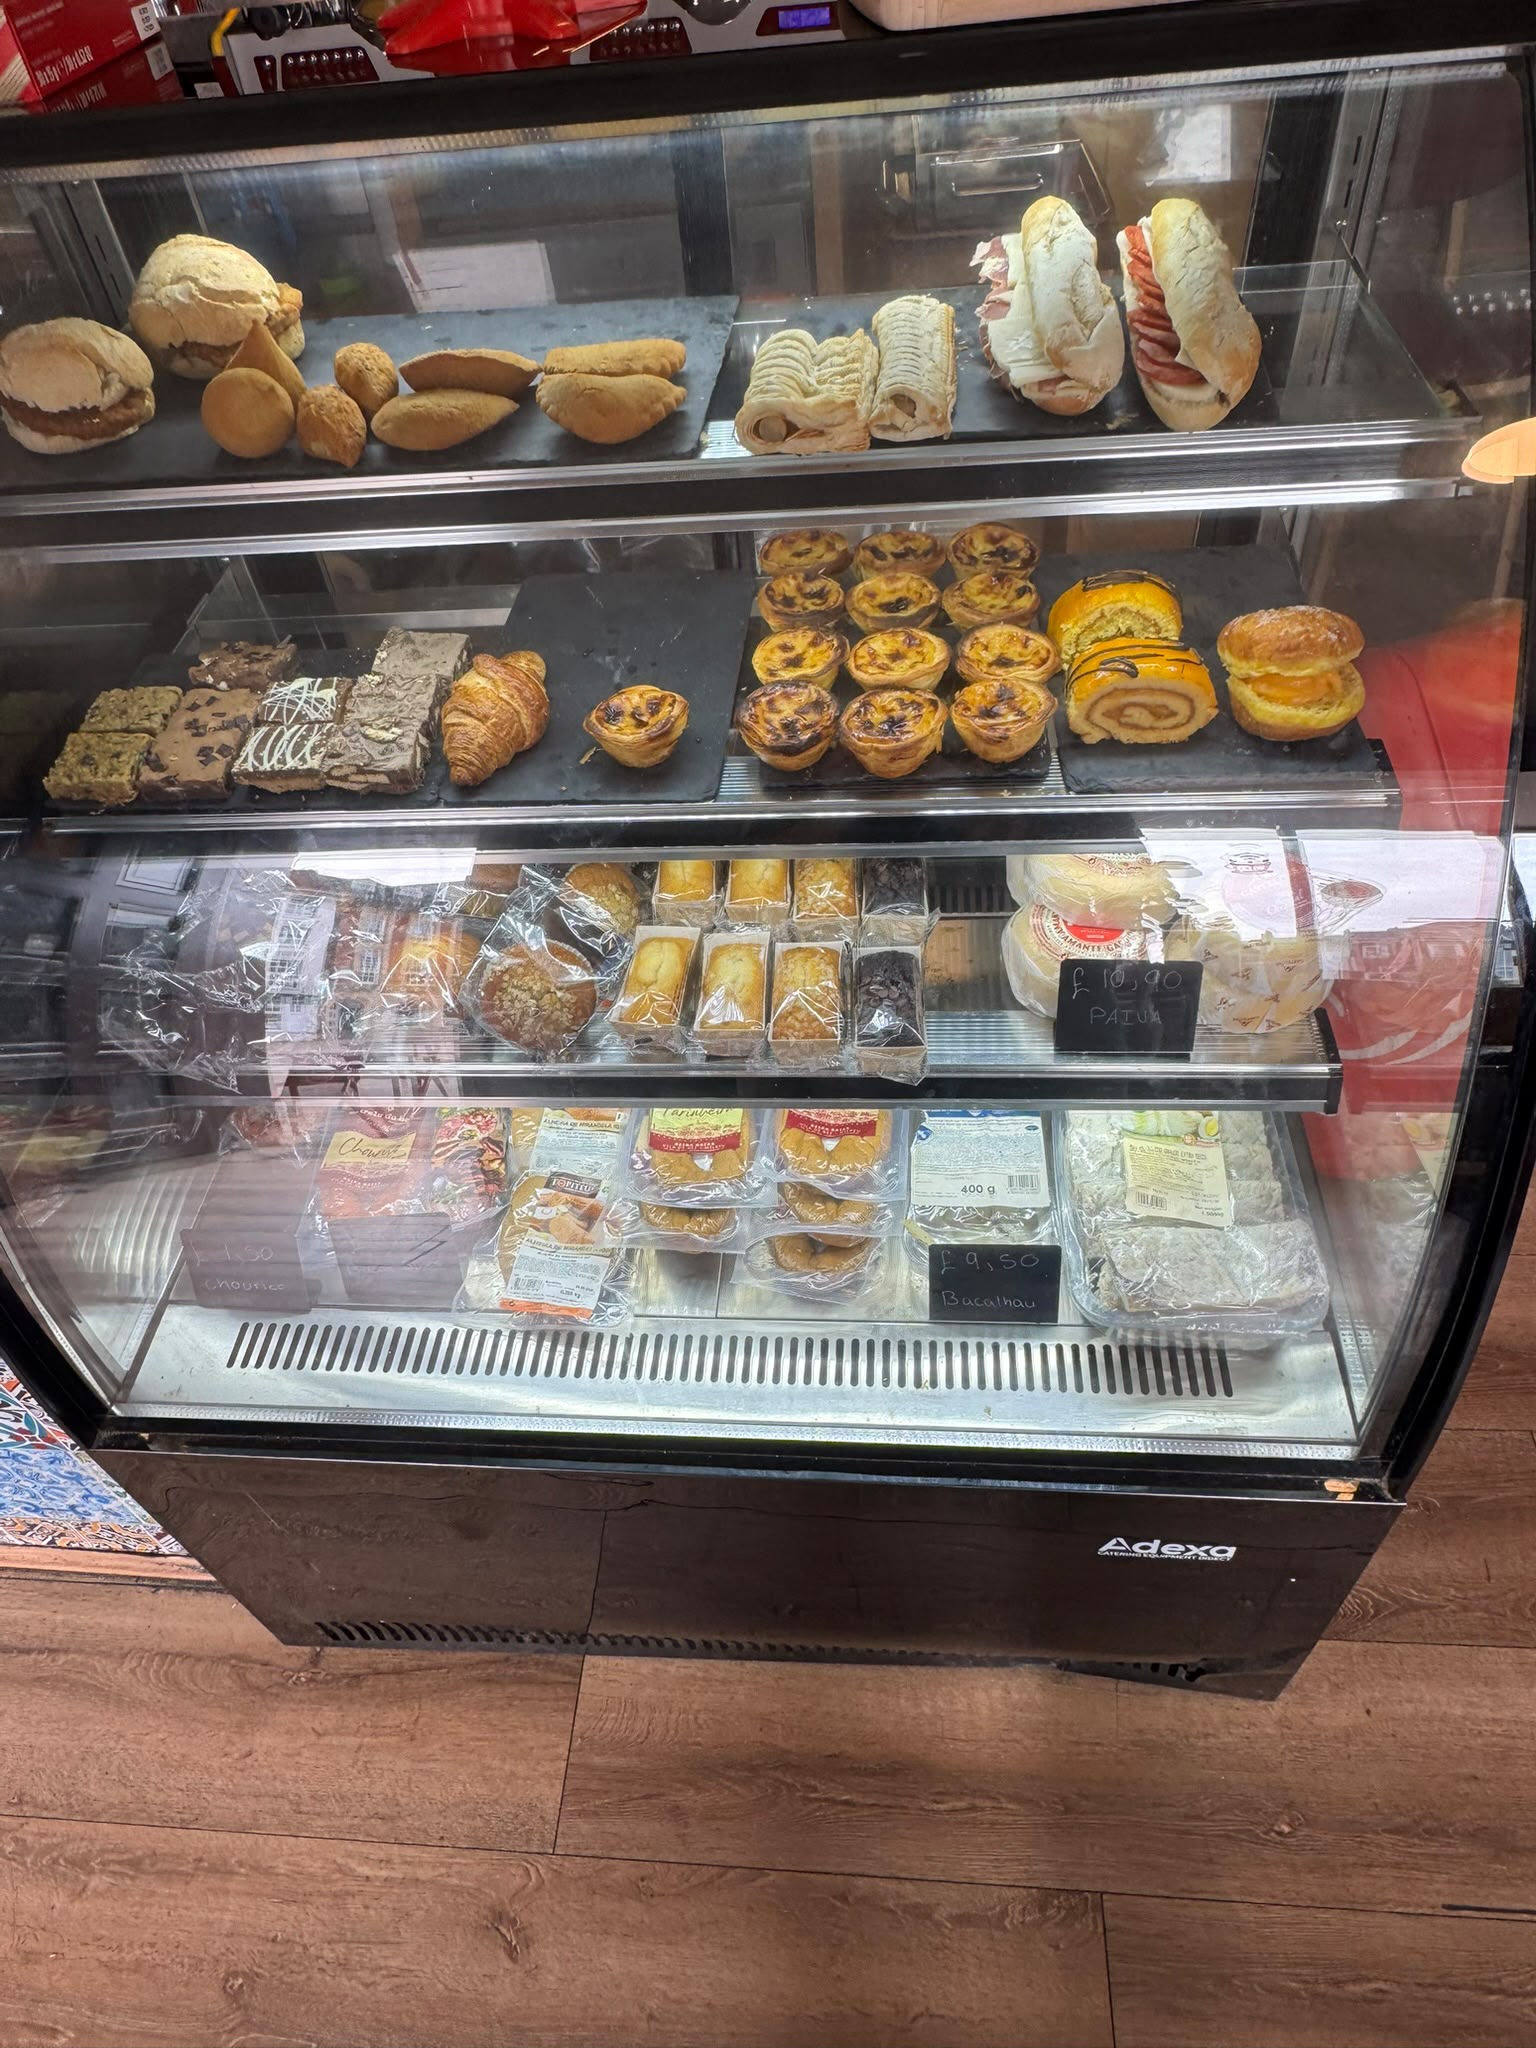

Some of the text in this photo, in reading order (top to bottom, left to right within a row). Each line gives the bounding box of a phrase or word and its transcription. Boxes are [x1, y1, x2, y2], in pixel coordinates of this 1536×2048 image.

[1073, 967, 1182, 999] £ 10,90
[961, 1184, 983, 1194] 400
[987, 1185, 995, 1195] g
[941, 1249, 1040, 1275] £ 9,50
[942, 1290, 1036, 1309] Bacalhau
[1098, 1537, 1237, 1558] Adexa
[1143, 1552, 1198, 1560] EQUIPMENT
